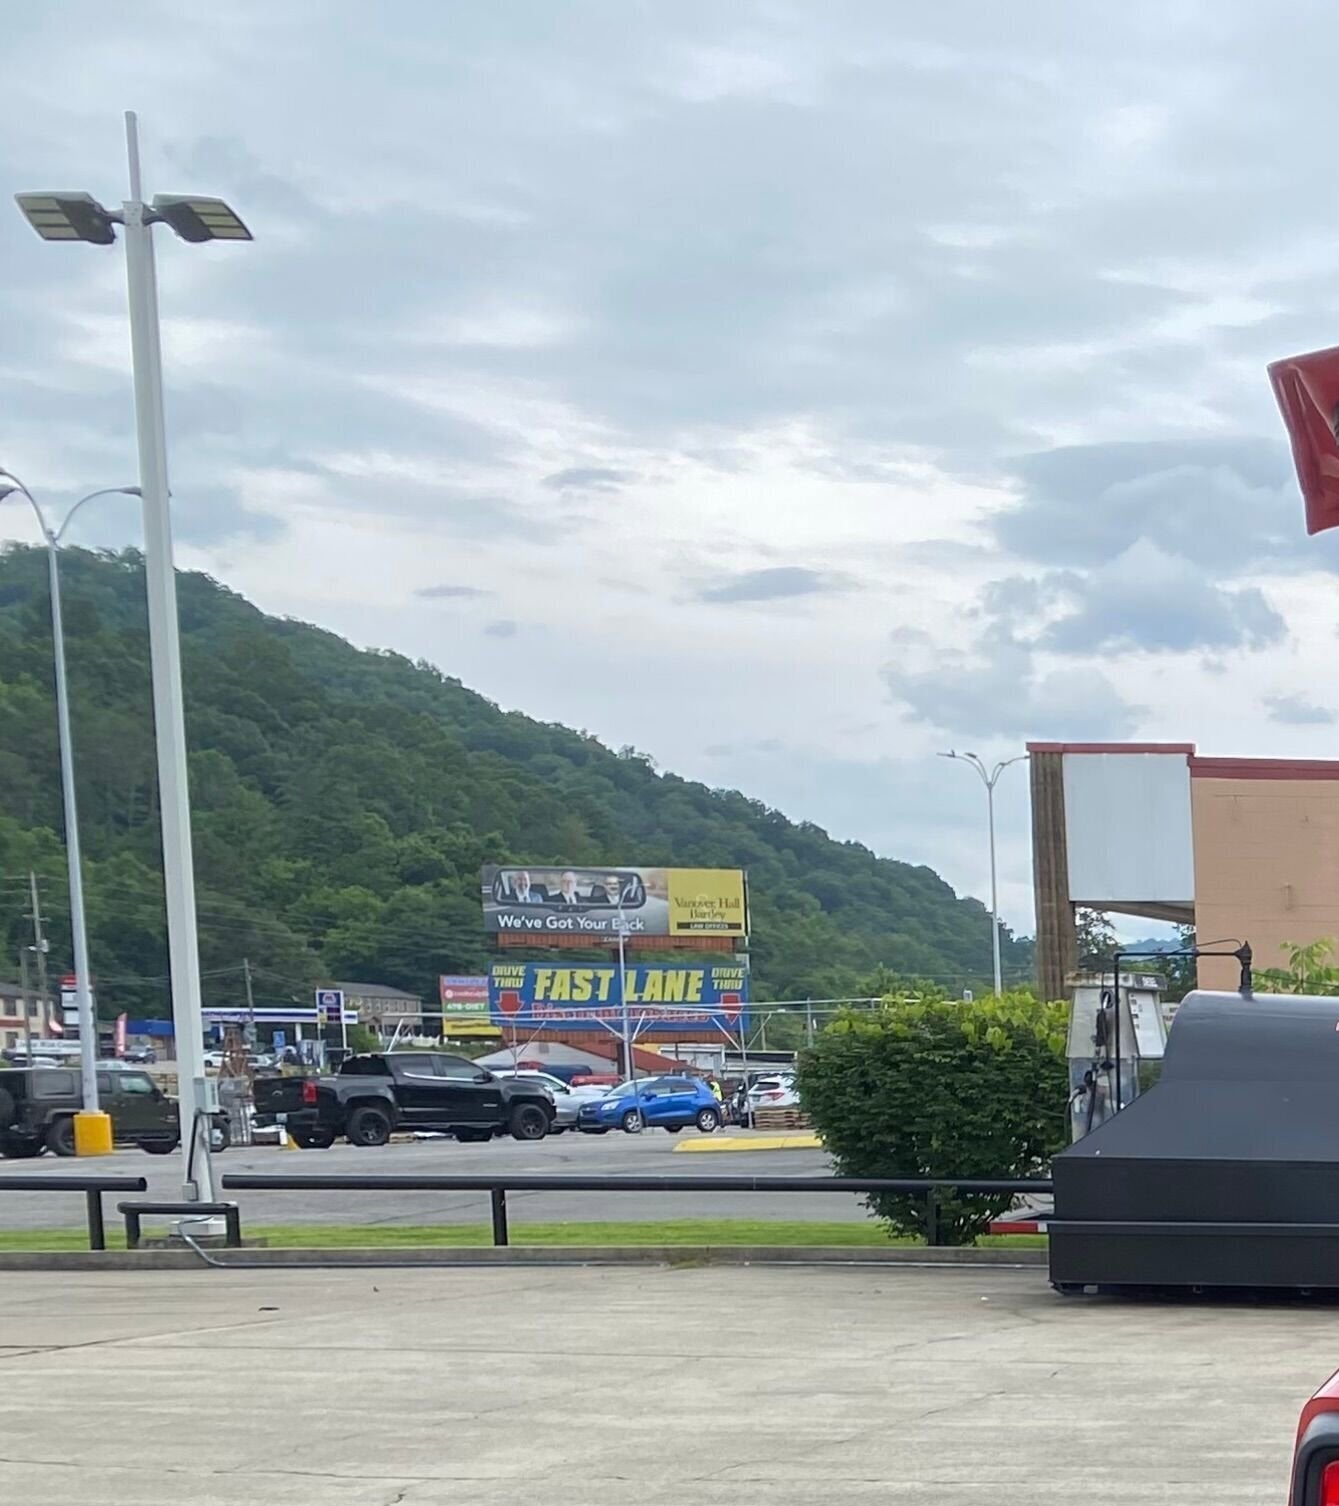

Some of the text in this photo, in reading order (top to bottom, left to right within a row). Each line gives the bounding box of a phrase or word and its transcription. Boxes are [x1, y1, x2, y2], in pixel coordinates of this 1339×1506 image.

[719, 897, 740, 908] Hall
[498, 915, 542, 929] We've
[546, 916, 574, 929] Got
[577, 917, 608, 930] Your
[492, 965, 526, 976] DRIVE
[711, 967, 745, 978] DRIVE
[494, 977, 525, 988] THRU
[532, 968, 705, 1002] FAST LANE
[713, 979, 743, 990] THRU
